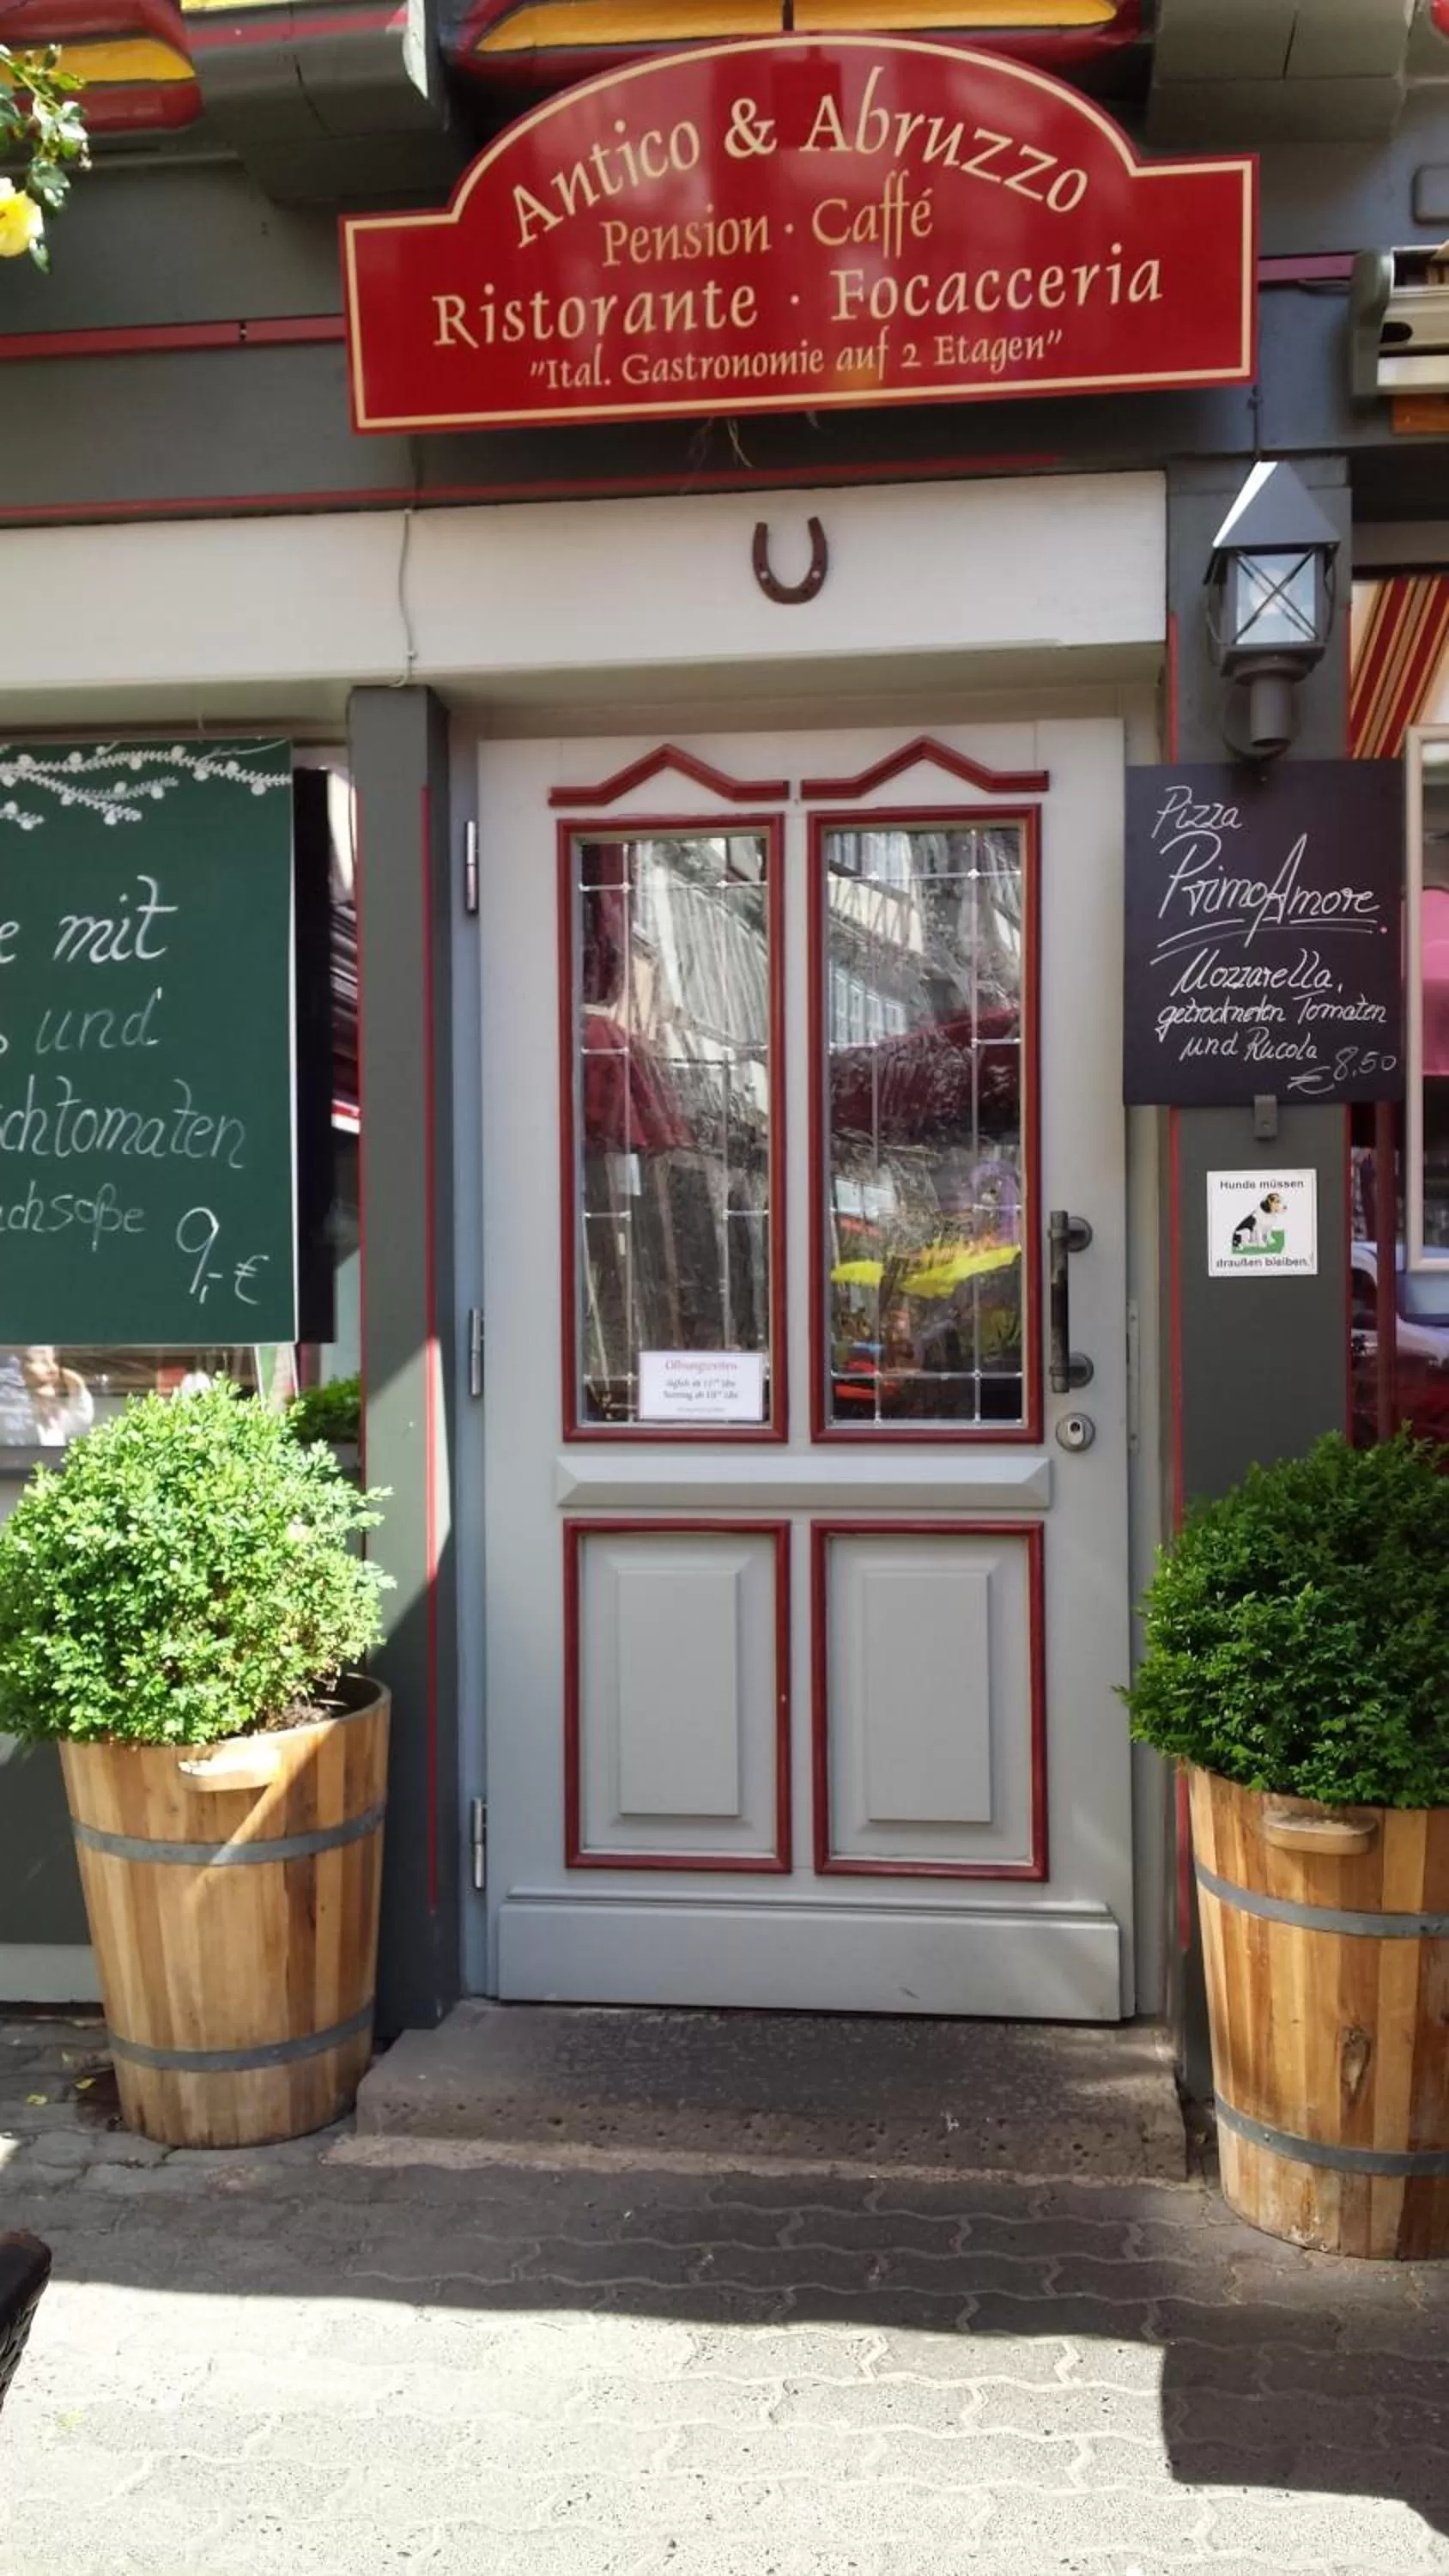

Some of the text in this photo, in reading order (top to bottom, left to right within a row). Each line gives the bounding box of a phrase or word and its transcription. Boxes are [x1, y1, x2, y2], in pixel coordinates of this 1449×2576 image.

[512, 65, 1088, 248] Antico & Abruzzo
[600, 204, 772, 267] Pension
[811, 170, 933, 259] Caffé
[432, 282, 758, 349] Ristorante
[829, 242, 1163, 322] Focacceria
[621, 340, 824, 385] Gastronomie
[835, 325, 890, 380] auf
[900, 343, 922, 368] 2
[1150, 785, 1244, 839] Pizza
[52, 874, 179, 964] mit
[35, 986, 162, 1055] und
[1291, 988, 1388, 1025] Tomaten
[1178, 1026, 1319, 1062] und Rucola
[0, 1073, 245, 1170] chtomaten
[0, 1179, 145, 1252] chsoße
[1219, 1179, 1305, 1190] Hunde müssen
